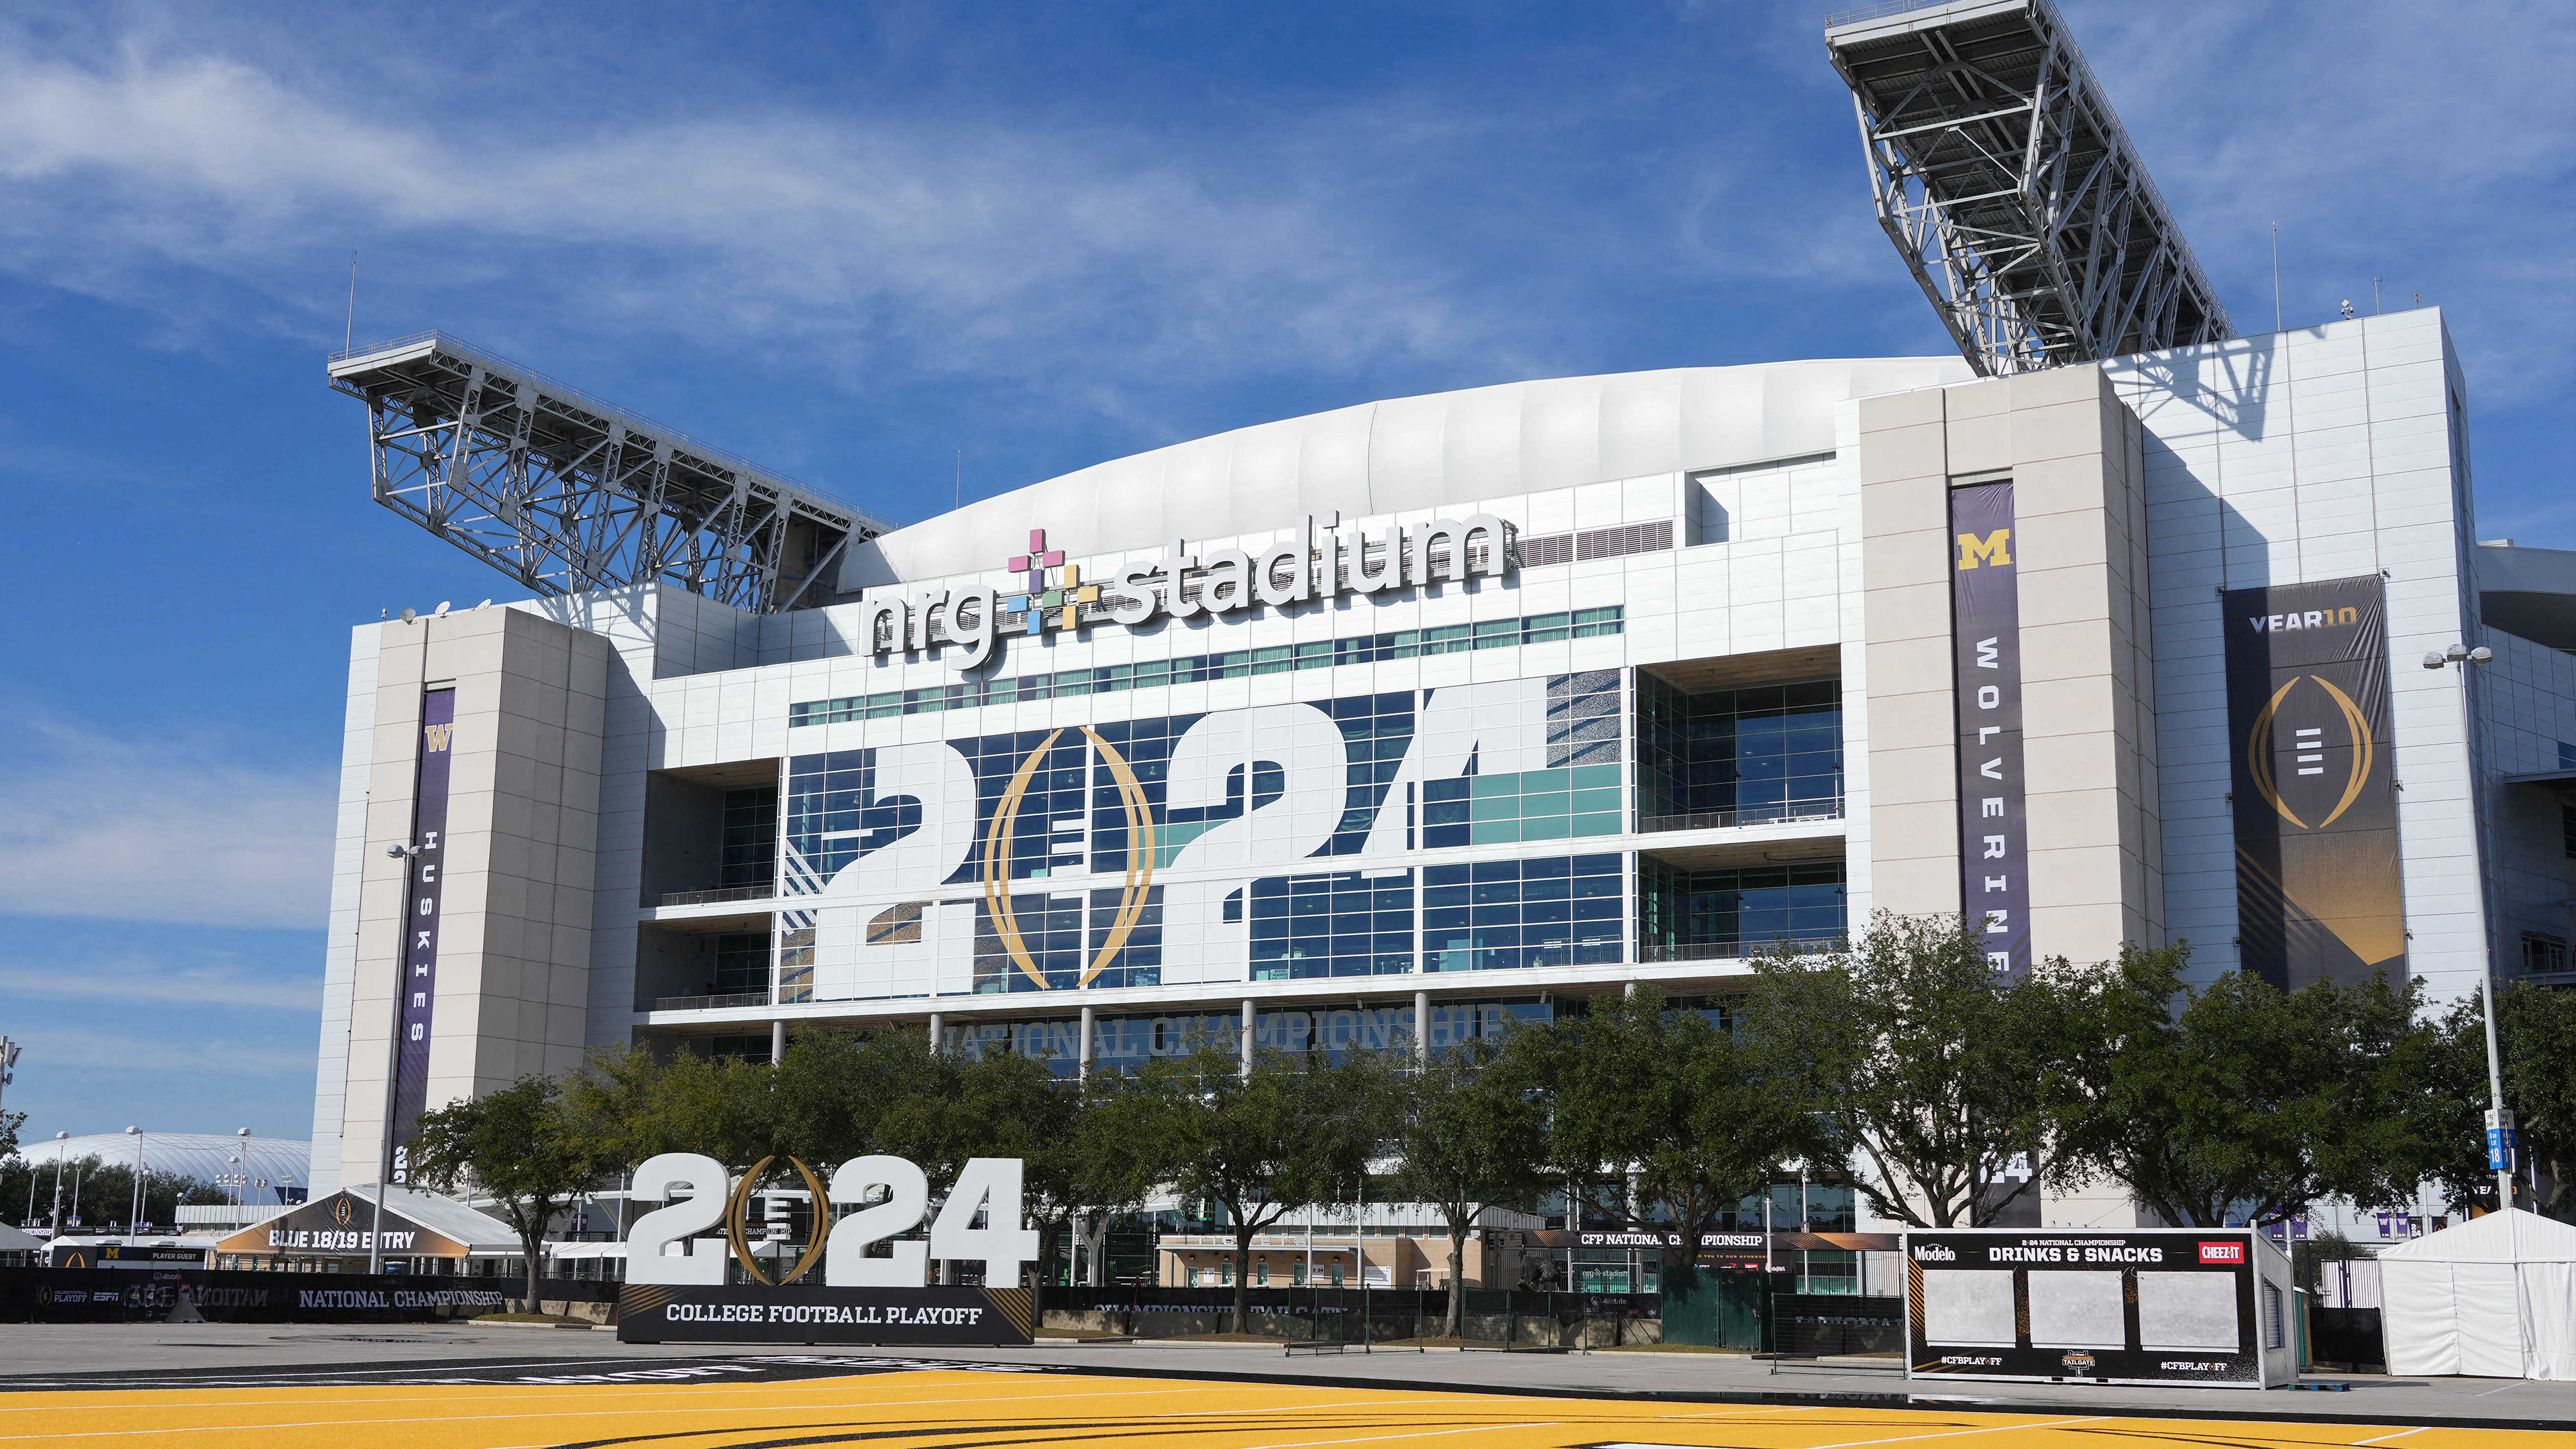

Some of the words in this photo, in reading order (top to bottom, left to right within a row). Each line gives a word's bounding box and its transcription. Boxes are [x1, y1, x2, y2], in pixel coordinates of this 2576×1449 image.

[1957, 529, 2010, 571] M
[861, 583, 998, 671] nrg
[1111, 510, 1509, 626] stadium
[2249, 606, 2358, 634] YEAR10
[425, 723, 453, 752] W
[1976, 636, 2010, 1004] WOLVERINE
[411, 830, 437, 1042] HUSKIES
[2490, 1148, 2500, 1163] 18
[269, 1230, 309, 1247] BLUE
[312, 1230, 358, 1250] 18/19
[362, 1232, 415, 1248] ETRY
[1199, 1236, 1307, 1246] TICETS
[1581, 1234, 1604, 1245] CFP
[1606, 1234, 1663, 1246] NATIONA
[1668, 1234, 1763, 1246] CHPIONSHIP
[105, 1248, 119, 1258] M
[1915, 1246, 1955, 1261] Modelo
[1989, 1247, 2061, 1262] DRINKS
[2066, 1248, 2080, 1262] &
[2085, 1248, 2163, 1263] SNACKS
[1582, 1270, 1595, 1278] nrg
[93, 1292, 119, 1301] ESPN
[299, 1290, 389, 1308] NATIONAL
[394, 1290, 502, 1308] CHAMPIONSHIP
[666, 1303, 763, 1322] COLLEGE
[768, 1305, 882, 1324] FOOTBALL
[886, 1307, 983, 1326] PLAYOFF
